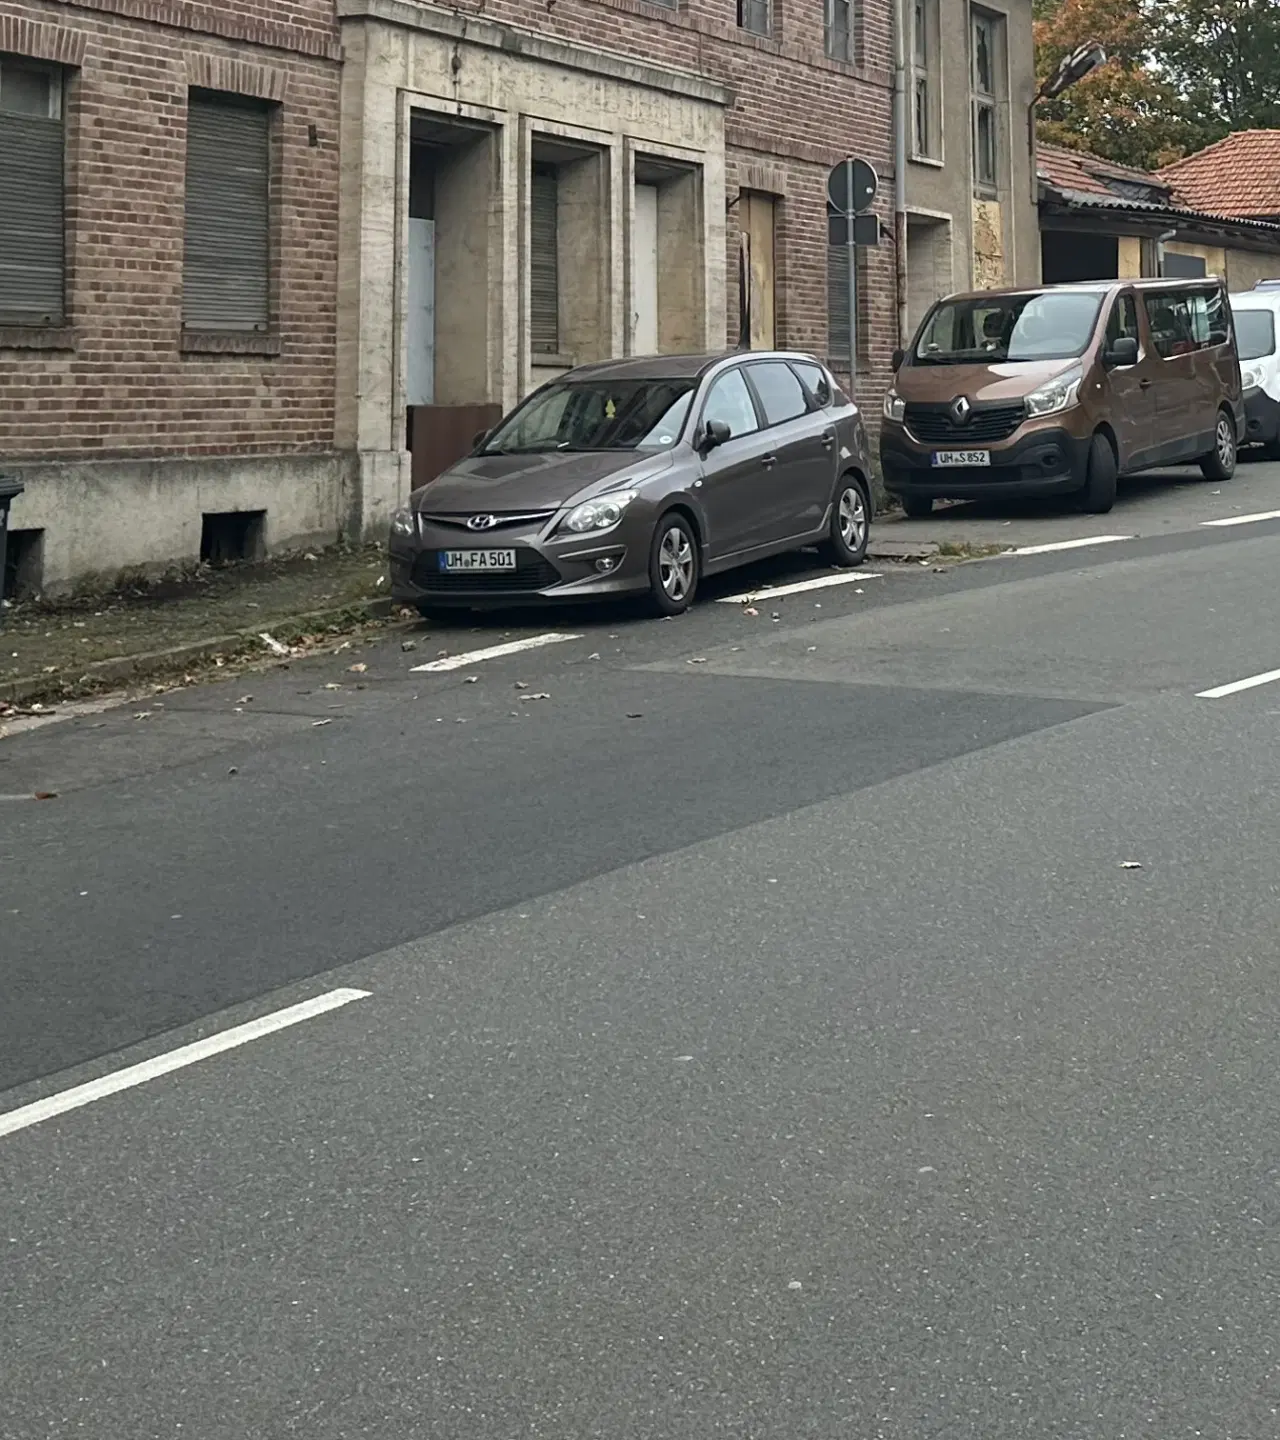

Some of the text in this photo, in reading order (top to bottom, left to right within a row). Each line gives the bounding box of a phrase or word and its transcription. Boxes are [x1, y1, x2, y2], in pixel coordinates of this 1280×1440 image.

[940, 453, 953, 464] UH
[966, 451, 985, 463] 852
[445, 551, 514, 567] UH FA 501
